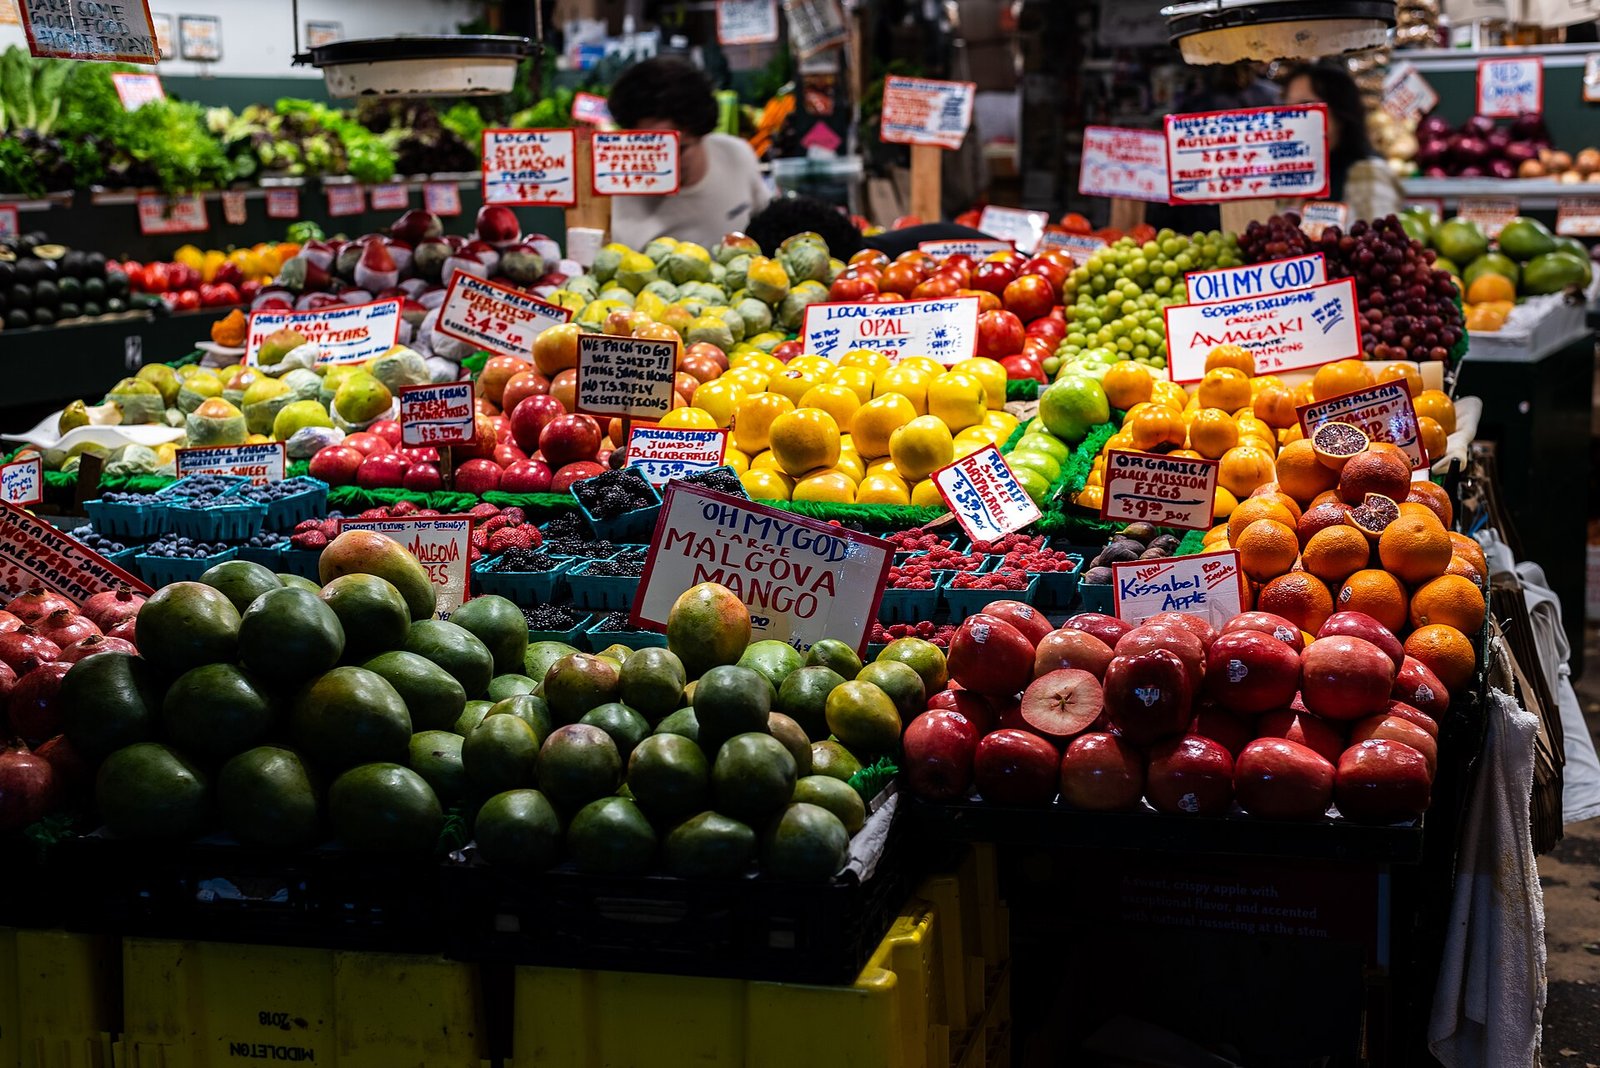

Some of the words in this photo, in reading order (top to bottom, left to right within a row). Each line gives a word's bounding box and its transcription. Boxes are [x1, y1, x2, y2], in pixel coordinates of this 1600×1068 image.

[495, 133, 550, 143] LOCAL
[1185, 120, 1282, 138] SEEDLESS
[1177, 134, 1237, 148] AUTUMN
[1244, 129, 1294, 143] CRISP
[496, 144, 544, 159] STAR
[599, 152, 668, 162] BARTLETT
[501, 169, 546, 182] PEARS
[610, 163, 656, 172] PEARS
[1232, 267, 1264, 296] MY
[459, 275, 495, 297] LOCAL
[503, 292, 533, 310] NEW
[531, 301, 565, 320] CROP
[461, 287, 537, 323] EVERCRISP
[827, 306, 872, 320] LOCAL
[874, 304, 922, 318] SWEET
[327, 325, 369, 342] PEARS
[860, 318, 911, 337] OPAL
[934, 328, 948, 339] WE
[1189, 316, 1303, 349] AMAGAKI
[581, 339, 599, 352] WE
[600, 340, 634, 353] PACK
[635, 344, 652, 355] TO
[652, 344, 672, 357] GO
[848, 338, 908, 349] APPLES
[1249, 342, 1304, 358] MMONS
[592, 354, 612, 364] WE
[582, 365, 615, 378] TAKE
[615, 366, 646, 380] SOME
[646, 369, 674, 384] HOME
[581, 378, 598, 393] NO
[409, 399, 448, 412] FRESH
[1307, 385, 1399, 420] AUSTRALIAN
[236, 444, 278, 455] FARMS
[628, 447, 720, 461] BLACKBERRIES
[230, 464, 268, 477] SWEET
[988, 450, 1010, 479] RED
[980, 463, 1014, 504] SWEET
[1112, 468, 1149, 482] BLACK
[1150, 473, 1208, 491] MISSION
[961, 456, 1012, 528] RASPBERRIES
[1133, 481, 1182, 500] FIGS
[1163, 511, 1192, 522] BOX
[376, 522, 406, 531] TEXTURE
[414, 521, 432, 530] NOT
[434, 520, 467, 532] STRINGY!
[742, 513, 790, 546] MY
[408, 533, 460, 562] MALGOVA
[715, 528, 791, 558] LARGE
[663, 527, 836, 598] MALGOVA
[1202, 560, 1222, 574] RED
[1136, 564, 1161, 580] NEW
[691, 563, 819, 620] MANGO
[1120, 574, 1201, 601] Kissabel
[1174, 880, 1210, 895] crispy
[1213, 883, 1247, 898] apple
[1249, 885, 1280, 898] with
[1195, 897, 1231, 912] flavor,
[1235, 902, 1258, 914] and
[1261, 905, 1318, 919] accented
[1199, 918, 1256, 935] russeting
[1259, 922, 1272, 932] at
[1274, 922, 1294, 935] the
[258, 1011, 290, 1027] 2018
[230, 1042, 315, 1062] MIDDLETON
